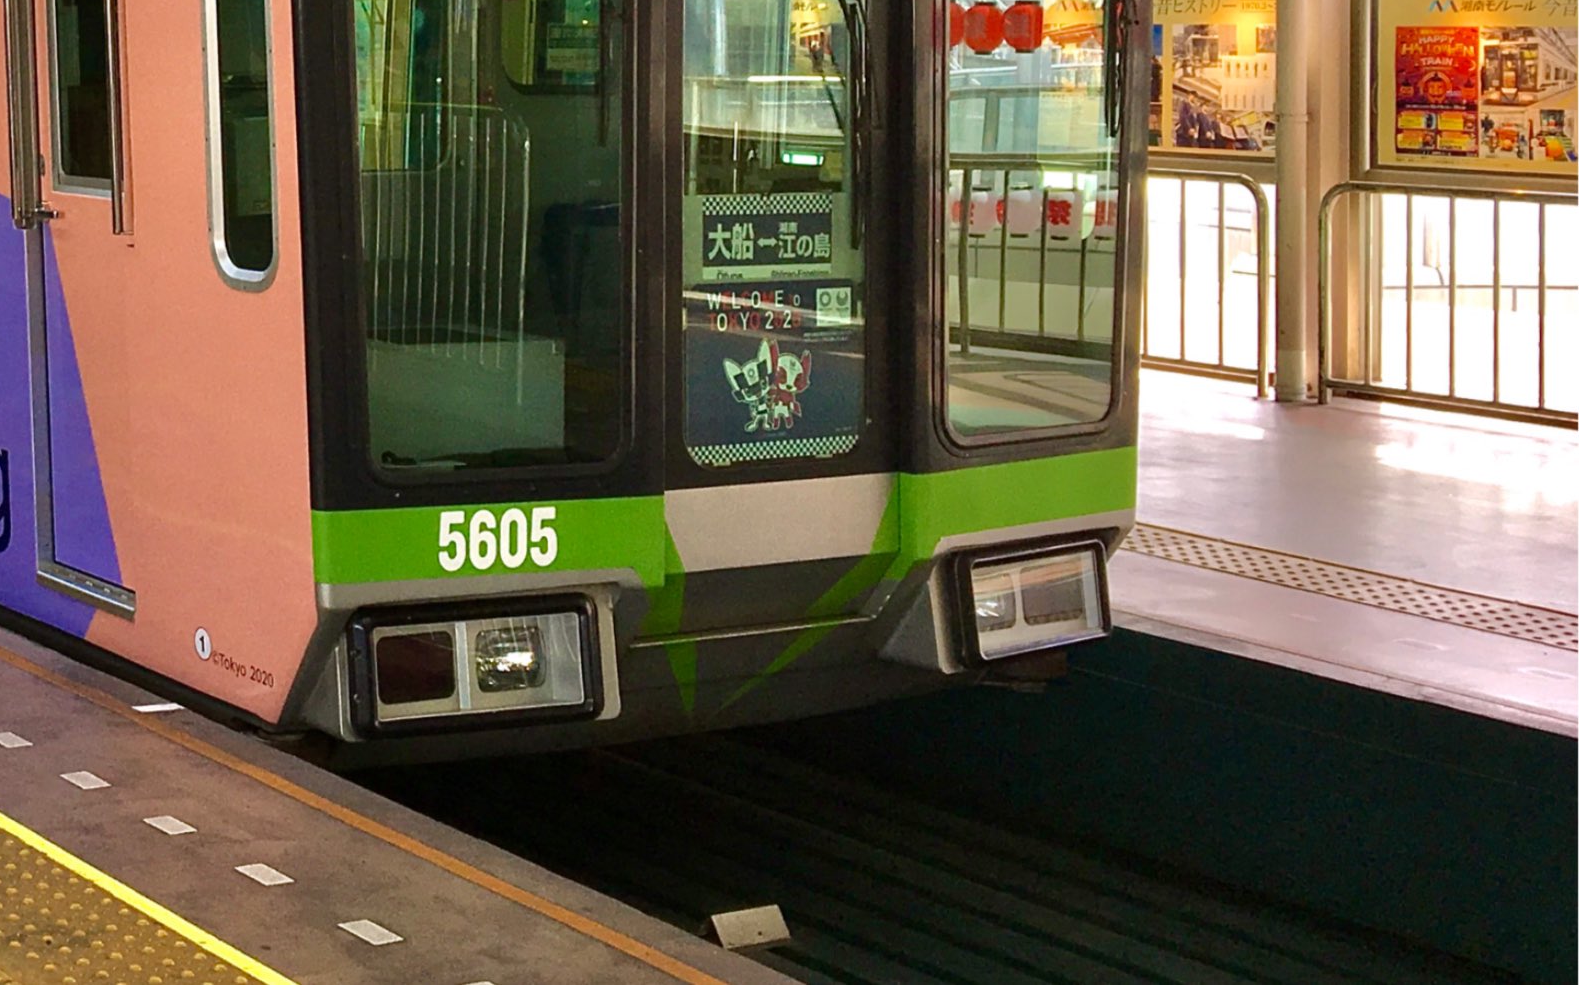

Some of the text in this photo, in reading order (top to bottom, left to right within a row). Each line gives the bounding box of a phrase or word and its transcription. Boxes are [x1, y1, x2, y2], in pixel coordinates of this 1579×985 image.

[1419, 35, 1454, 44] HAPPY
[1420, 57, 1453, 66] TRAIN
[708, 223, 831, 260] 大船 江の島
[438, 506, 558, 572] 5605
[250, 665, 274, 688] 2020
